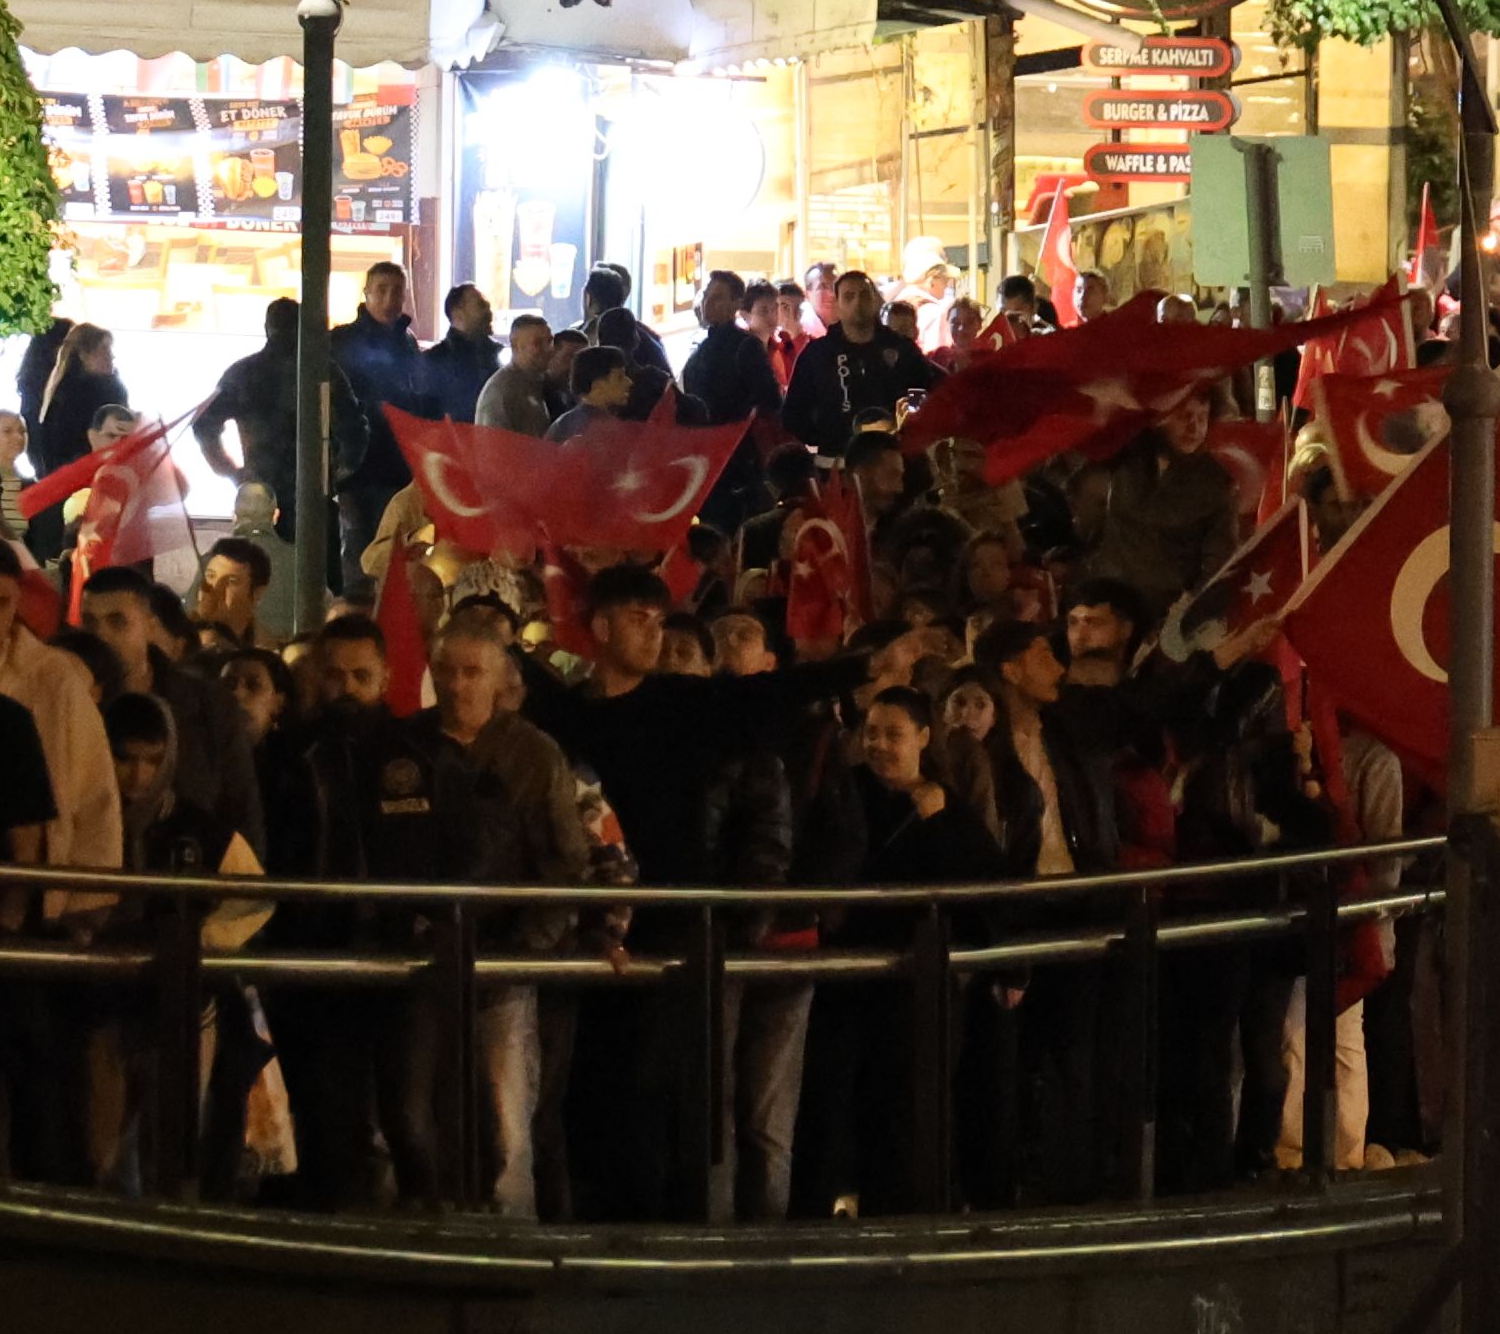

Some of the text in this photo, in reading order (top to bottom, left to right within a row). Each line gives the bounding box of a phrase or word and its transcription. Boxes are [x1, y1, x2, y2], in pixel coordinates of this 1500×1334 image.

[1152, 49, 1214, 66] KAHVALTI
[220, 105, 287, 122] ET DÖNER
[1104, 99, 1209, 121] BURGER & PİZZA
[1106, 155, 1191, 172] WAFFLE & PAS
